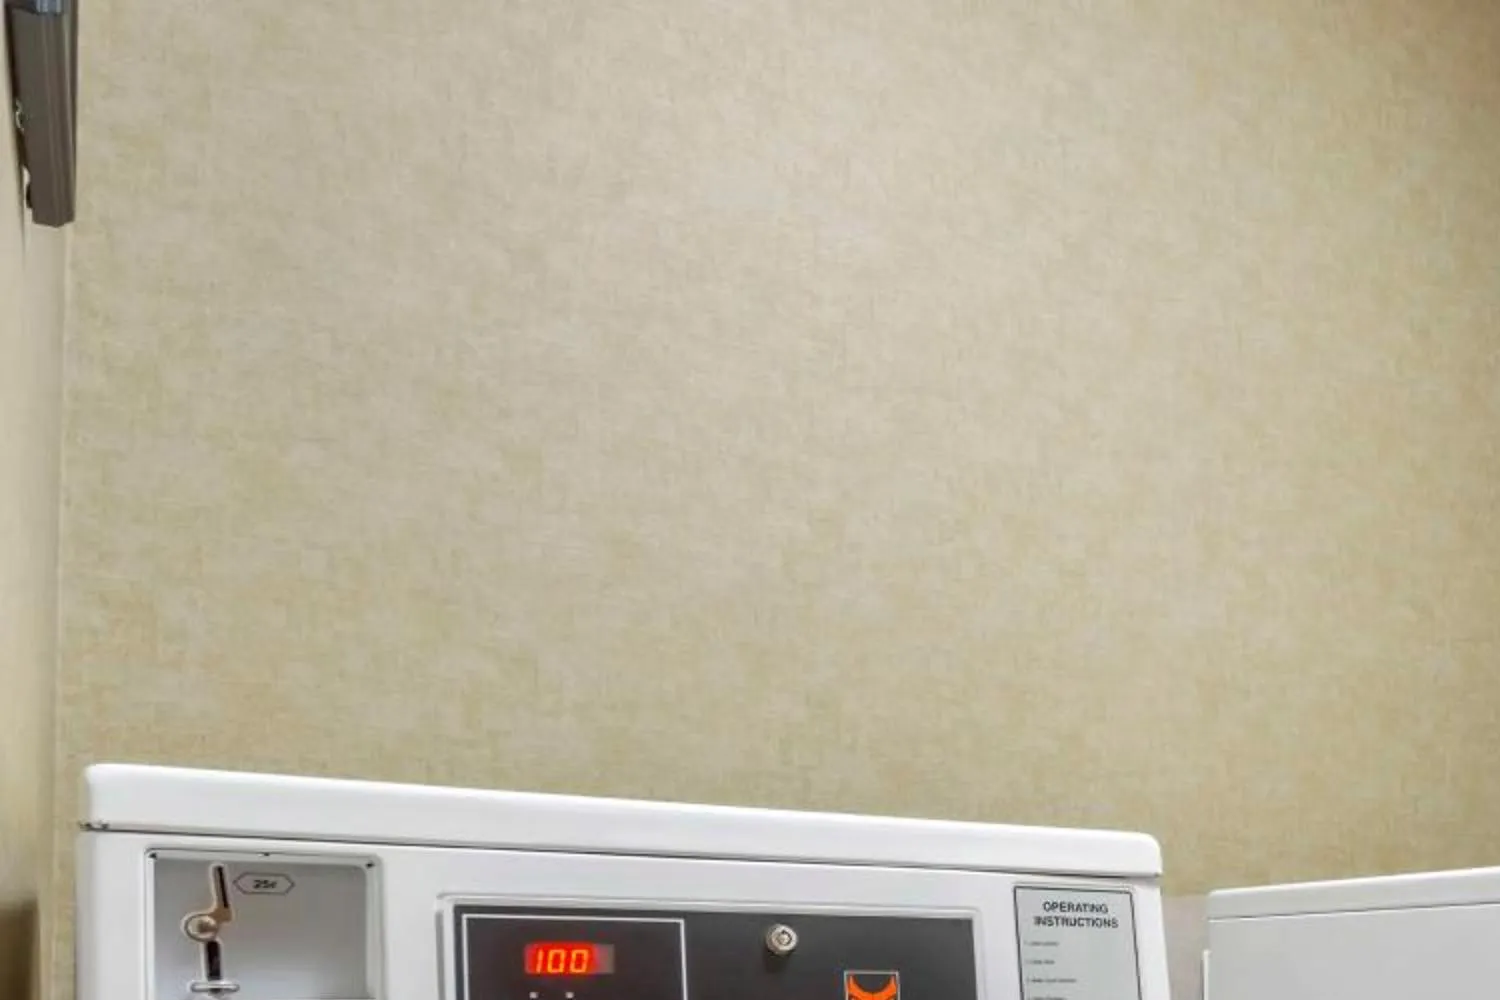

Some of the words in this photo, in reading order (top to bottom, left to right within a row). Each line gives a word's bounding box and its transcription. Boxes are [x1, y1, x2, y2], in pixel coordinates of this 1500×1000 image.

[1042, 901, 1109, 914] OPERATING
[1033, 915, 1119, 929] INSTRUCTIONS
[535, 948, 590, 974] 100
